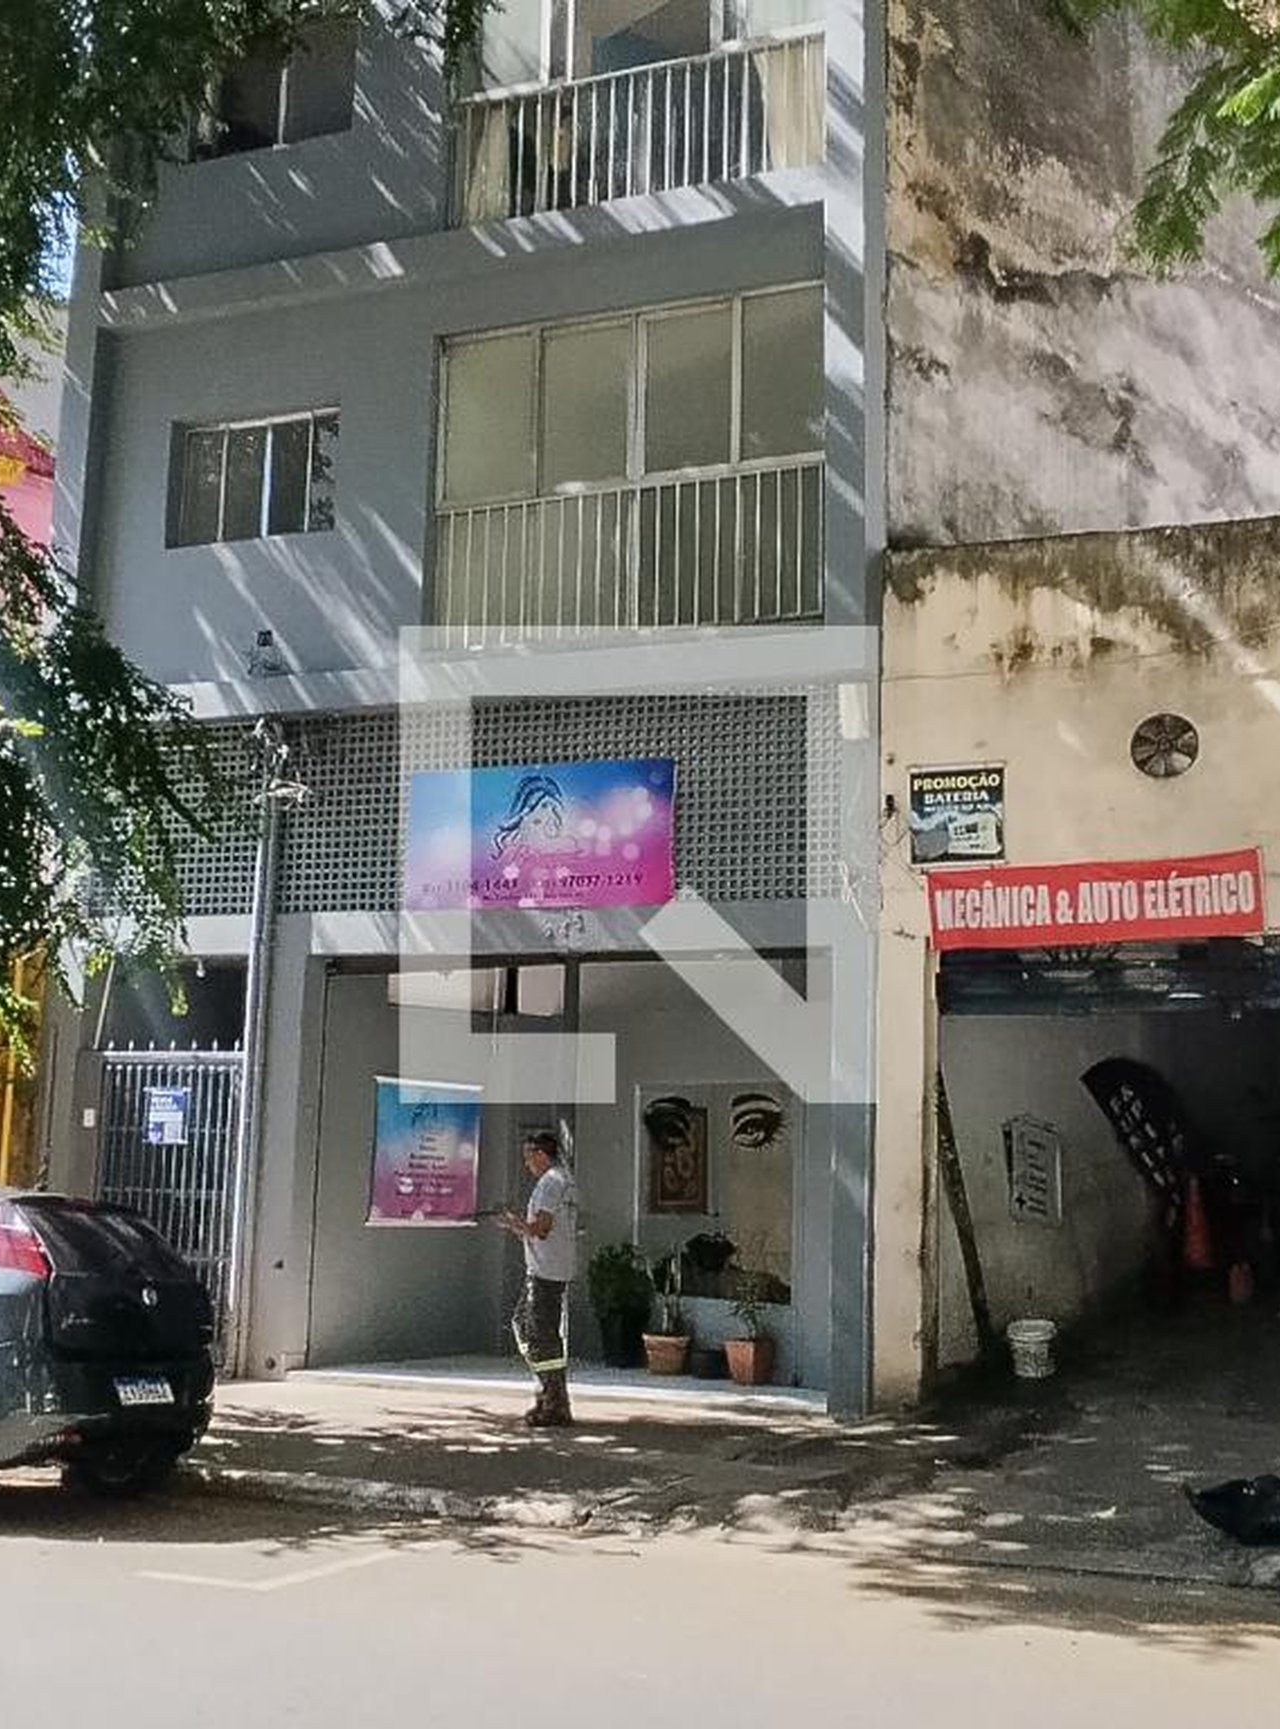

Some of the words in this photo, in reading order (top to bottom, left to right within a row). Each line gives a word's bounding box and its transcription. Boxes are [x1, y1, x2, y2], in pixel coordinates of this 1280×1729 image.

[913, 772, 1000, 791] PROMOÇÃO
[924, 790, 989, 804] BATERIA
[935, 880, 1052, 931] MECÂNICA
[1056, 889, 1073, 924] &
[1078, 880, 1139, 924] AUTO
[1143, 870, 1255, 919] ELÉTRICO
